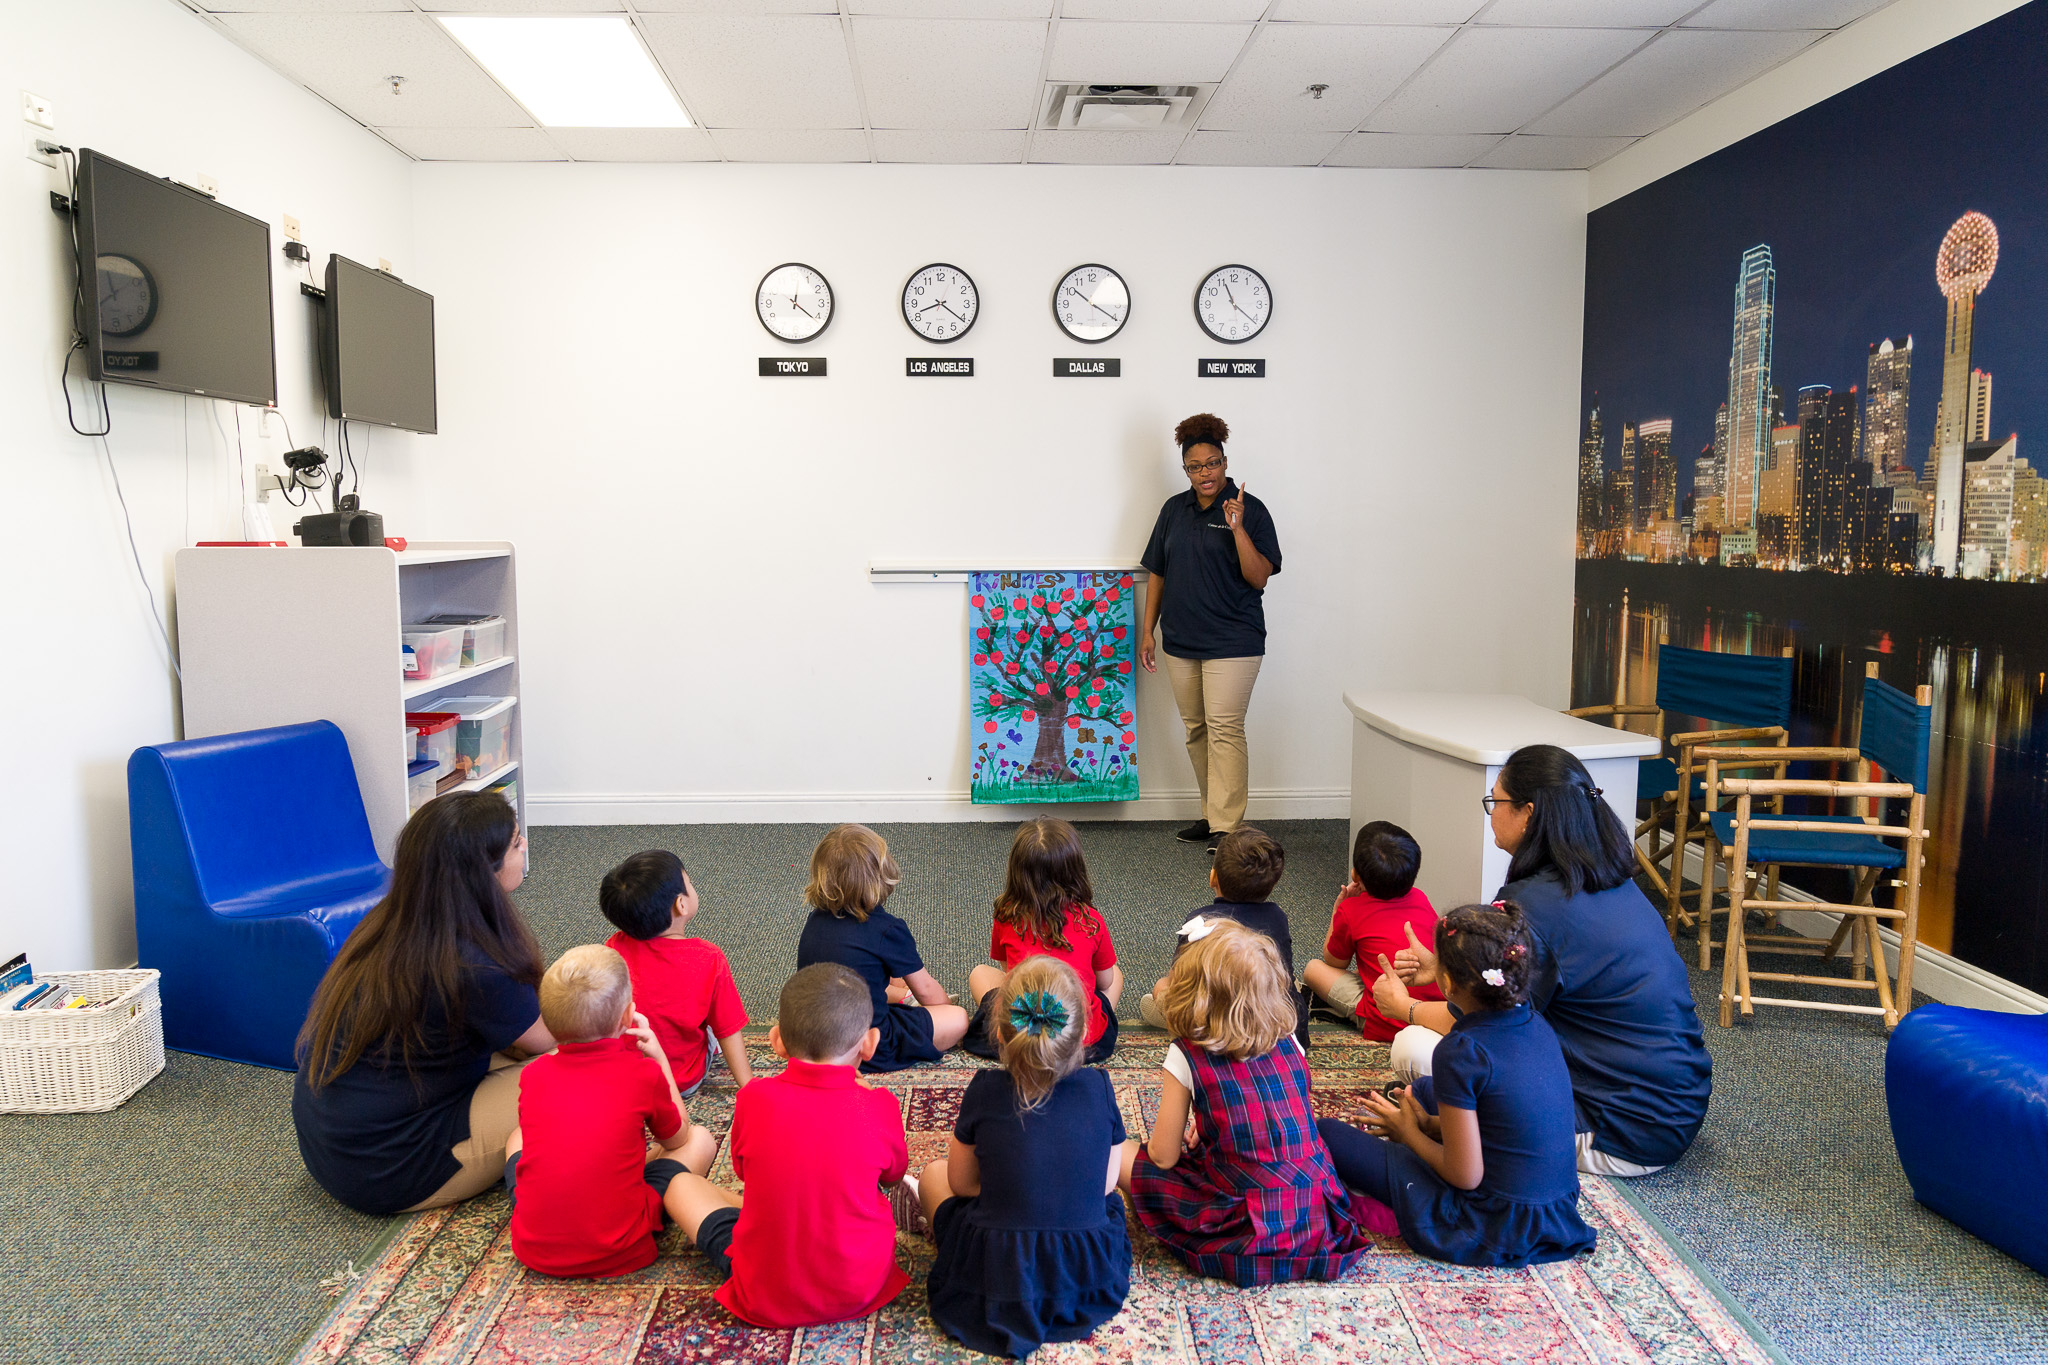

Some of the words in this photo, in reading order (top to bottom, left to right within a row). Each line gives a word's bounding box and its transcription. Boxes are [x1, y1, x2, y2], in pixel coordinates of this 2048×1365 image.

[806, 276, 810, 284] 1
[924, 277, 932, 286] 11
[936, 272, 945, 282] 12
[951, 276, 956, 285] 1
[1087, 273, 1096, 282] 12
[1229, 273, 1239, 283] 12
[1245, 277, 1249, 285] 1
[1075, 278, 1083, 286] 11
[1217, 278, 1226, 287] 11
[815, 284, 821, 294] 2
[914, 286, 925, 295] 10
[960, 285, 967, 295] 2
[1066, 286, 1076, 296] 10
[1208, 287, 1219, 296] 10
[1253, 286, 1260, 295] 2
[765, 299, 773, 308] 9
[818, 298, 825, 308] 3
[911, 299, 918, 308] 9
[963, 299, 970, 309] 3
[1062, 299, 1069, 309] 9
[1204, 300, 1211, 309] 9
[1256, 300, 1263, 309] 3
[914, 312, 921, 322] 8
[960, 313, 966, 323] 4
[1066, 313, 1073, 322] 8
[1208, 313, 1215, 323] 8
[1253, 314, 1259, 322] 4
[925, 322, 932, 331] 7
[937, 325, 944, 335] 6
[950, 322, 957, 331] 5
[1218, 323, 1225, 332] 7
[1230, 326, 1237, 335] 6
[1243, 323, 1249, 332] 5
[777, 362, 808, 372] TOKYO
[911, 362, 927, 372] LOS
[931, 362, 969, 372] ANGELES
[1069, 363, 1105, 372] DALLAS
[1208, 363, 1228, 373] NEW
[1232, 363, 1256, 373] YORK
